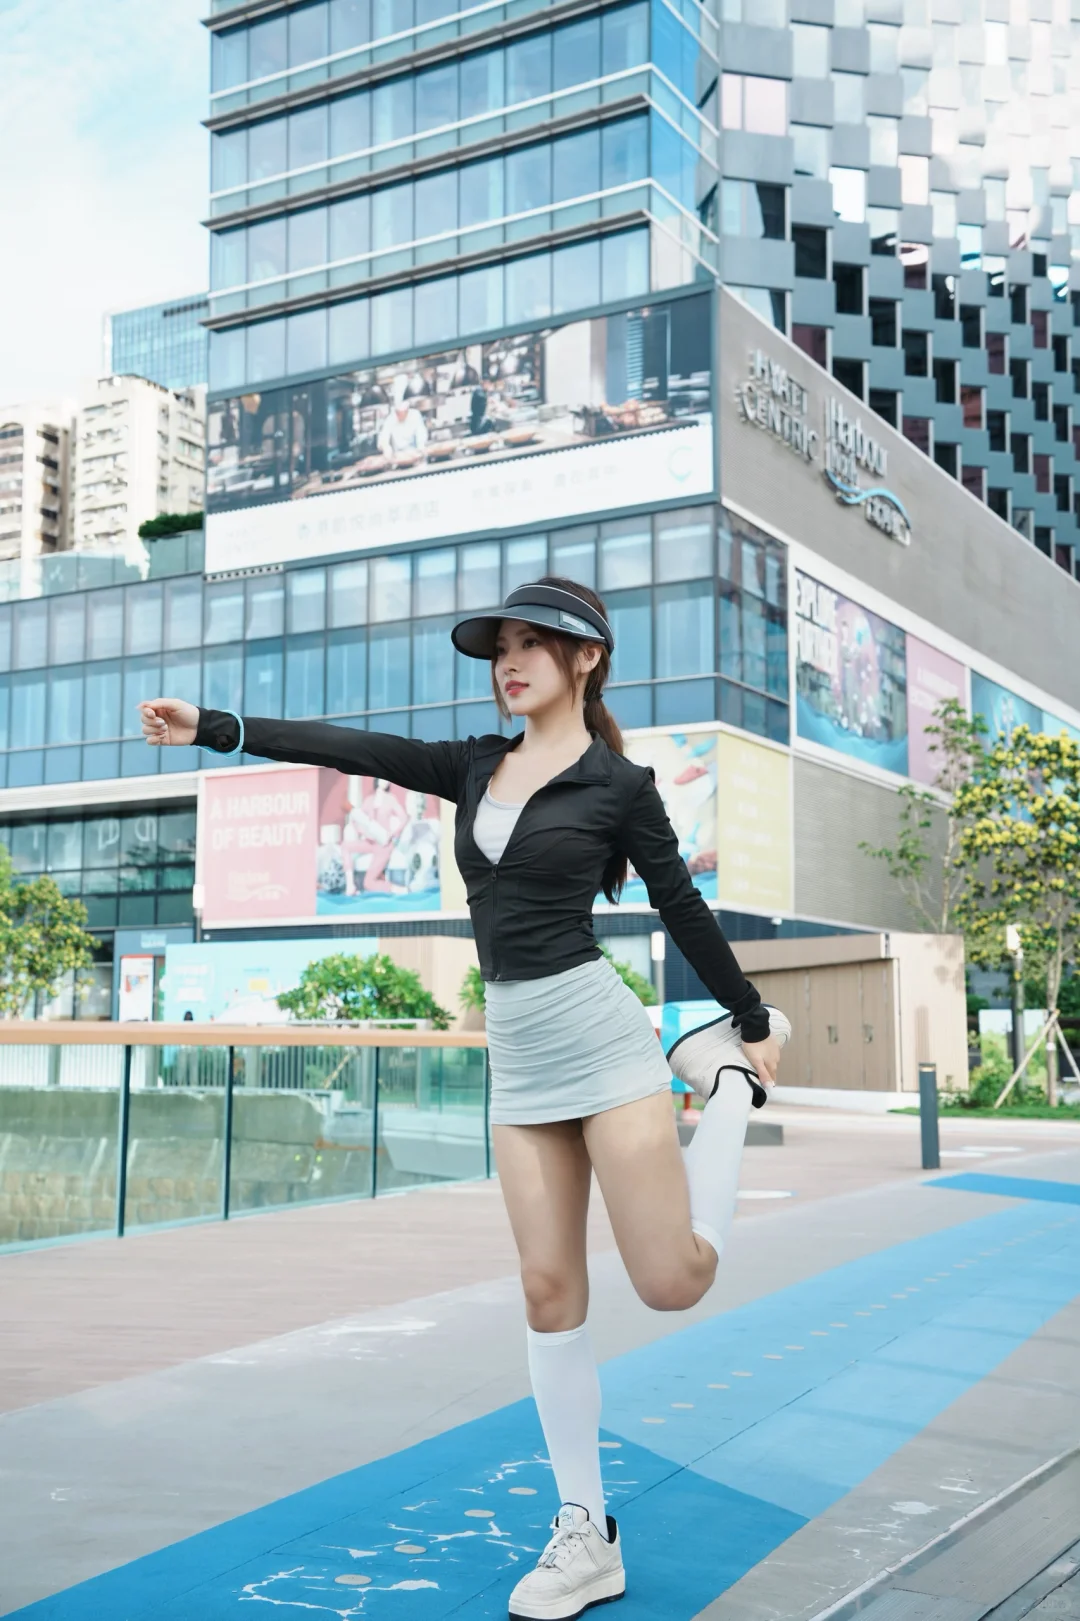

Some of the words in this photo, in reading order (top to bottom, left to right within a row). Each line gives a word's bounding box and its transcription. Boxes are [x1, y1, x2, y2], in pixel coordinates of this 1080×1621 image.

[740, 381, 820, 461] CENTRIC
[825, 396, 887, 478] Harbour
[209, 796, 223, 820] A
[227, 791, 310, 819] HARBOUR
[212, 827, 234, 850] OF
[239, 821, 306, 849] BEAUTY
